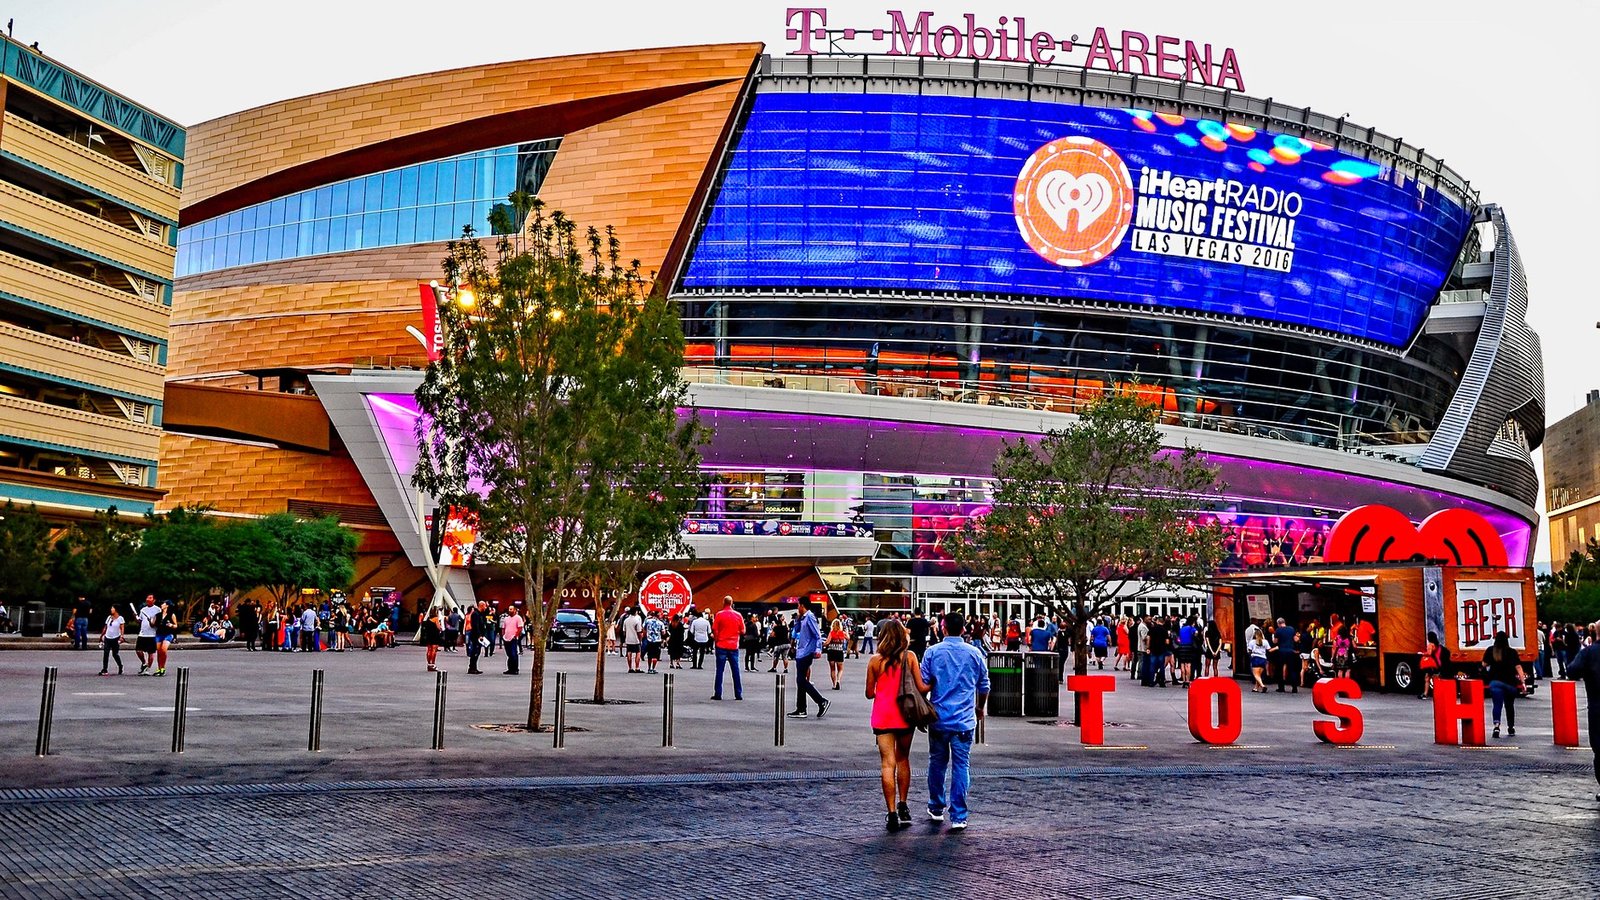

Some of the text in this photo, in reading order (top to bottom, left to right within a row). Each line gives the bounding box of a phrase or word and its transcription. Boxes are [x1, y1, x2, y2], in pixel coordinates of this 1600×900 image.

[1084, 27, 1246, 92] ARENA
[1138, 166, 1303, 217] iHeartRADIO
[1135, 196, 1296, 250] MUSIC FESTIVAL
[1135, 231, 1290, 270] LAS VEGAS 2016
[1462, 597, 1519, 648] BEER
